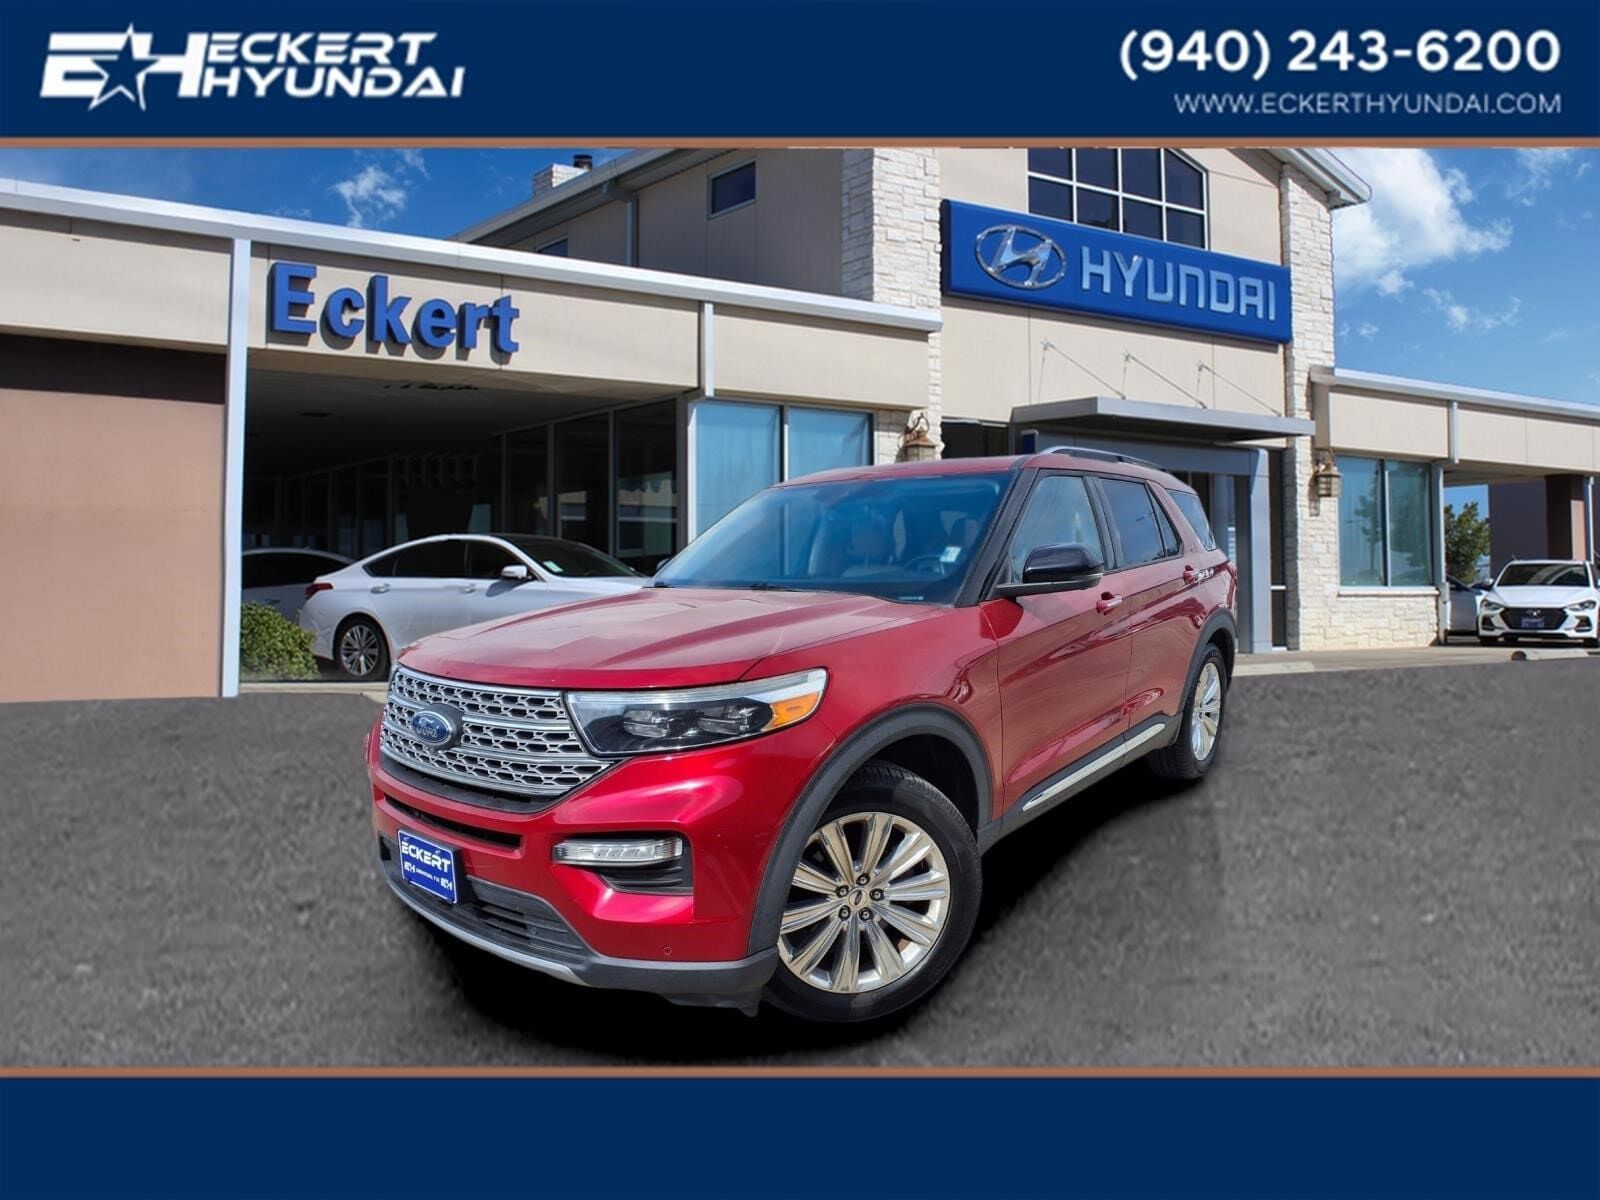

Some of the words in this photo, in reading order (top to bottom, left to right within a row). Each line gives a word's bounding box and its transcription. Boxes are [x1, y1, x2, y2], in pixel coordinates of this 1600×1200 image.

[269, 261, 520, 354] Eckert
[1081, 246, 1276, 321] HYUNDAI
[401, 841, 451, 873] ECKERT
